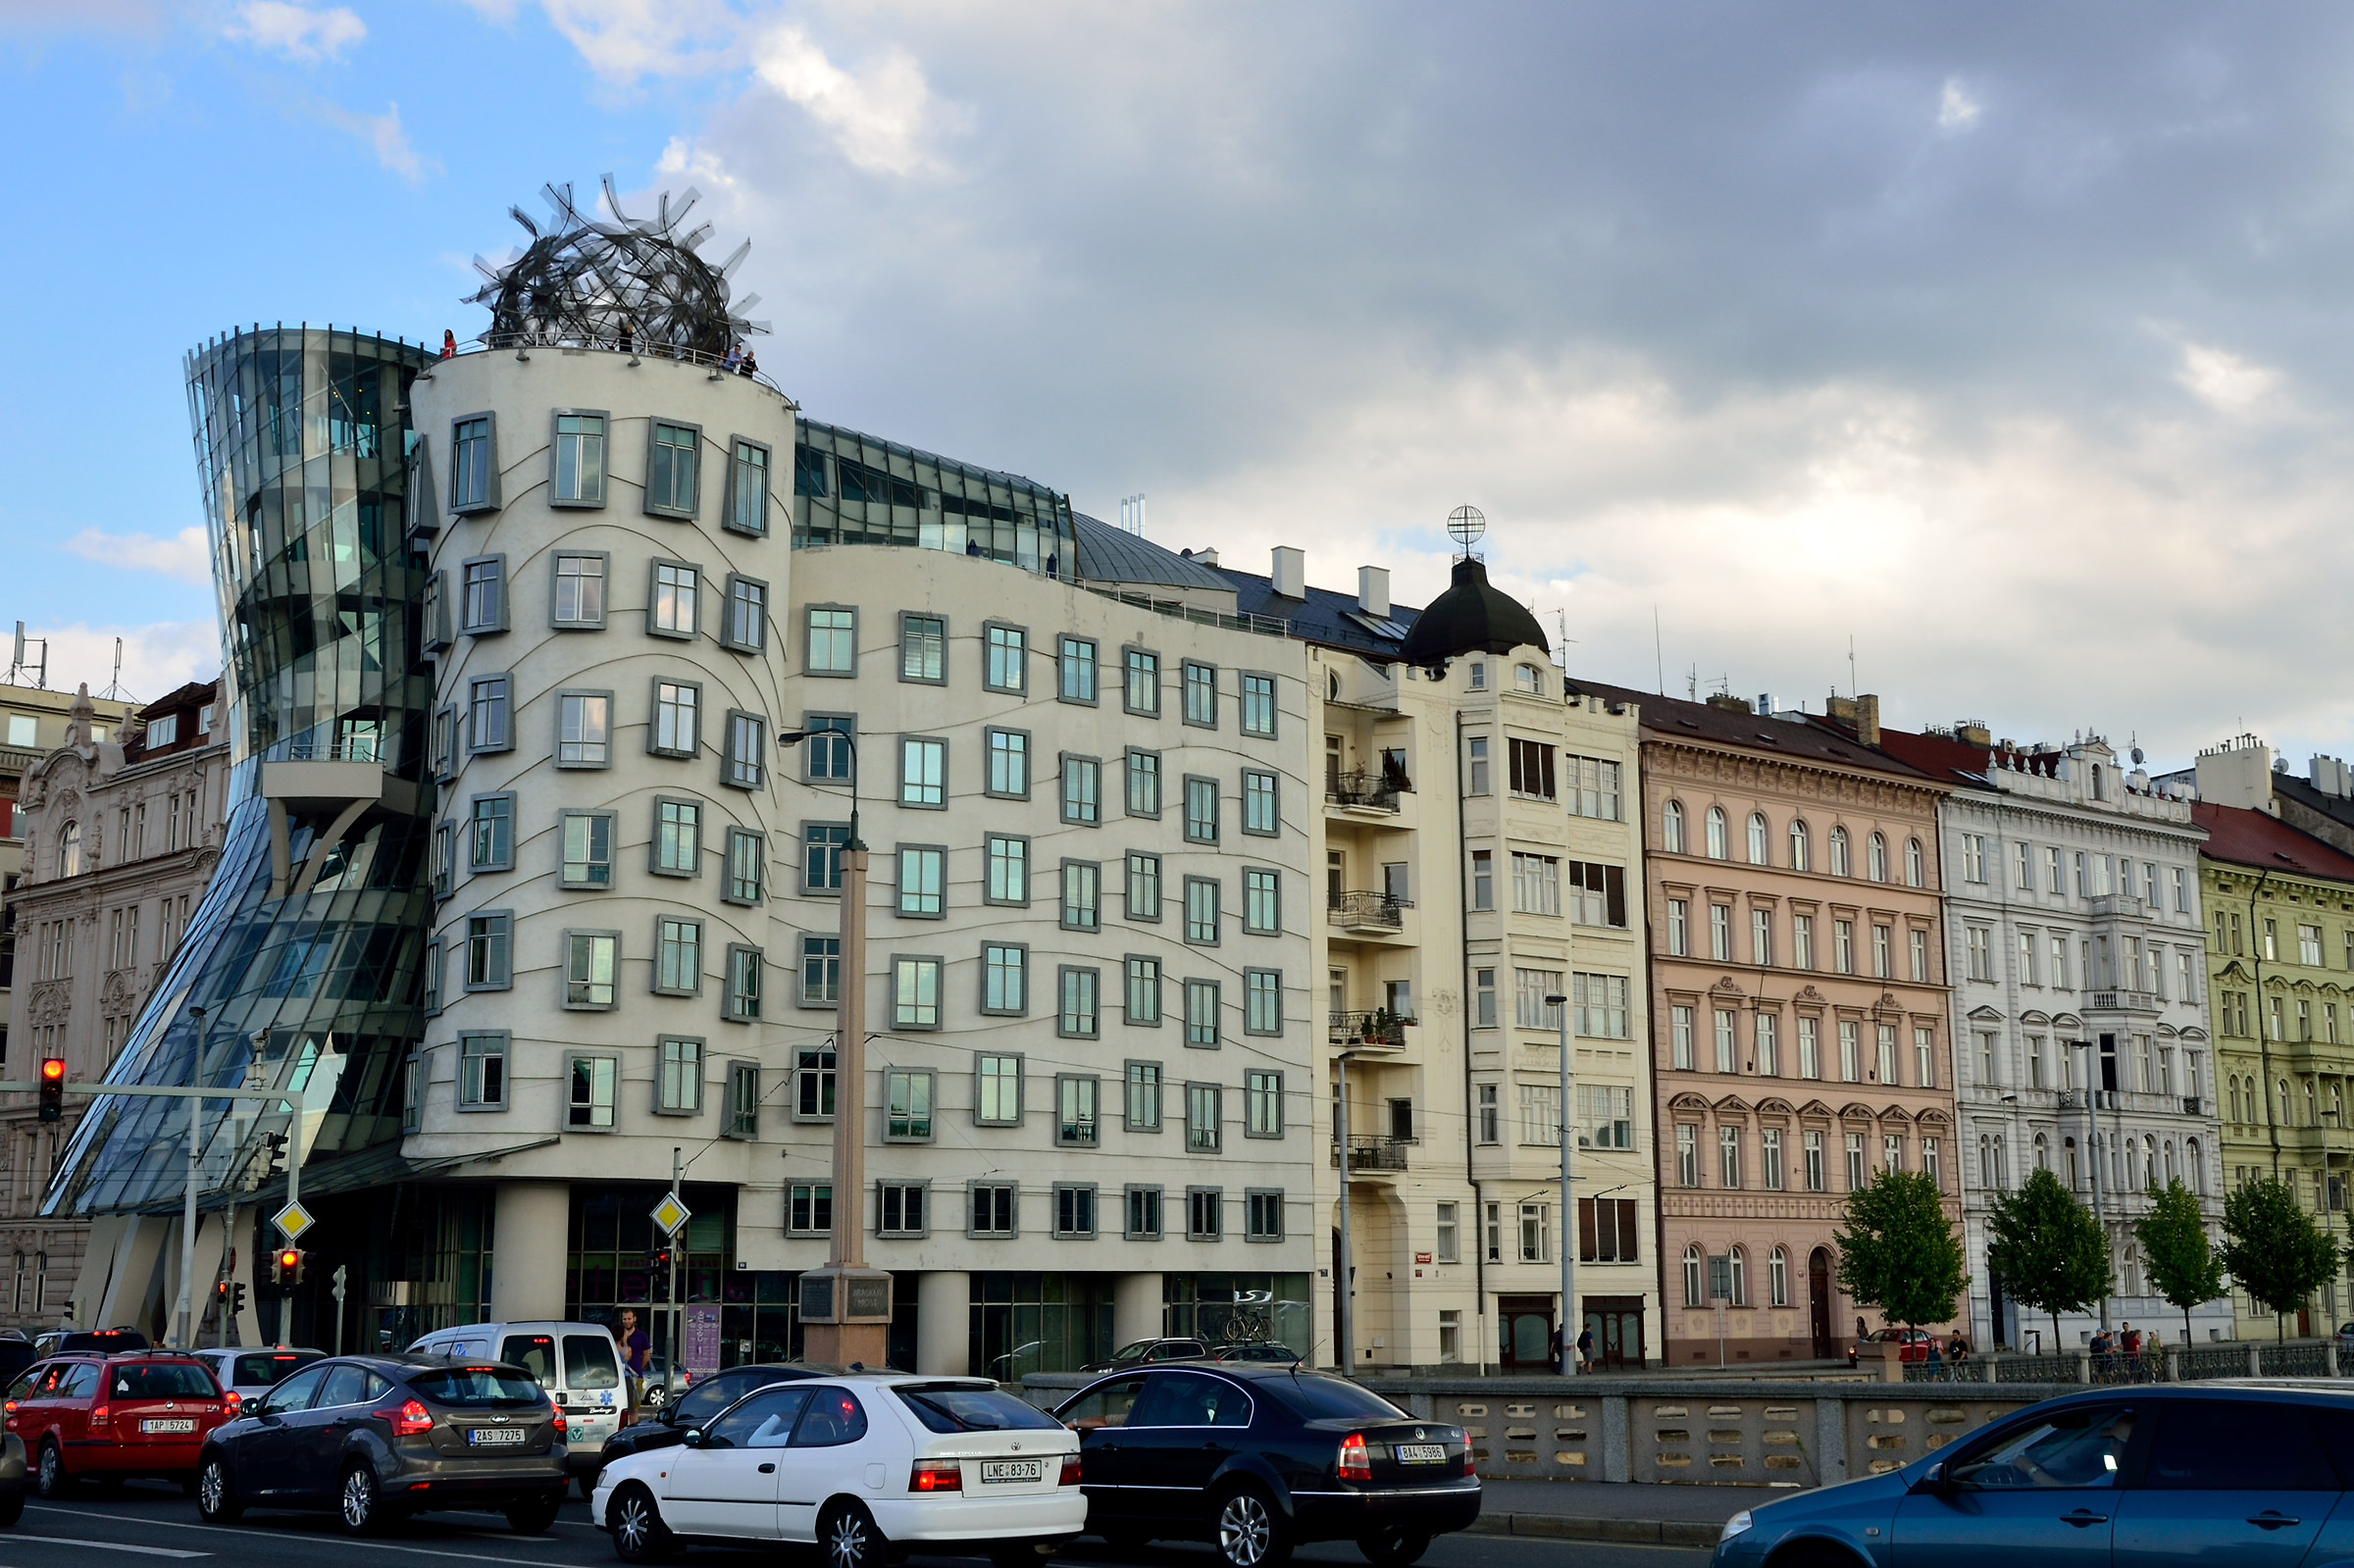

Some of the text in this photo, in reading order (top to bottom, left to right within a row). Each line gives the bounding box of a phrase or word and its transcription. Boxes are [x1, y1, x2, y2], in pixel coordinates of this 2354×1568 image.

[150, 1421, 189, 1430] 1AP 5724
[477, 1430, 521, 1442] 2AS 7275
[1403, 1446, 1442, 1458] 8A4 5986
[987, 1463, 1037, 1478] LNE 83-76
